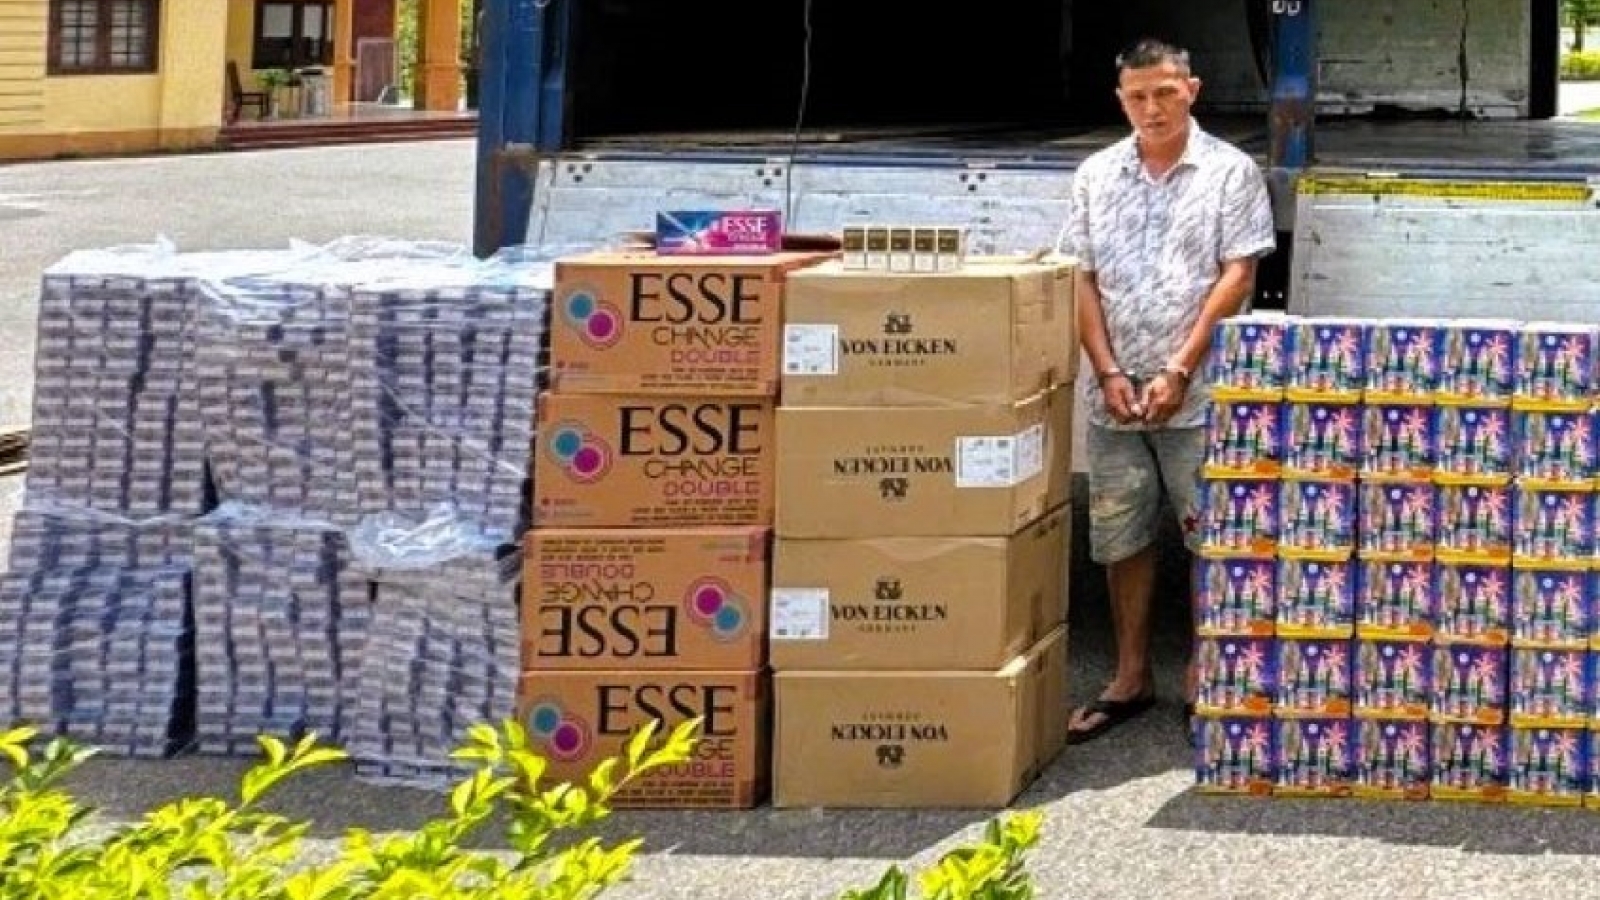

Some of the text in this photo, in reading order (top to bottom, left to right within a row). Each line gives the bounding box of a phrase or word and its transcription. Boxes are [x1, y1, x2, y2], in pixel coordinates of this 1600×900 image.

[722, 215, 768, 234] ESSE
[630, 272, 764, 325] ESSE
[652, 325, 760, 349] CHANGE
[840, 337, 957, 354] VON EICKEN
[671, 349, 760, 364] DOUBLE
[619, 403, 762, 456] ESSE
[643, 456, 760, 480] CHANGE
[833, 456, 910, 474] EICKEN
[914, 456, 954, 473] VON
[664, 480, 760, 497] DOUBLE
[540, 563, 635, 579] DOUBLE
[542, 578, 655, 603] CHANGE
[831, 604, 869, 621] VON
[873, 603, 948, 621] EICKEN
[538, 604, 679, 657] ESSE
[595, 682, 738, 737] ESSE
[831, 722, 949, 741] VON EICKEN
